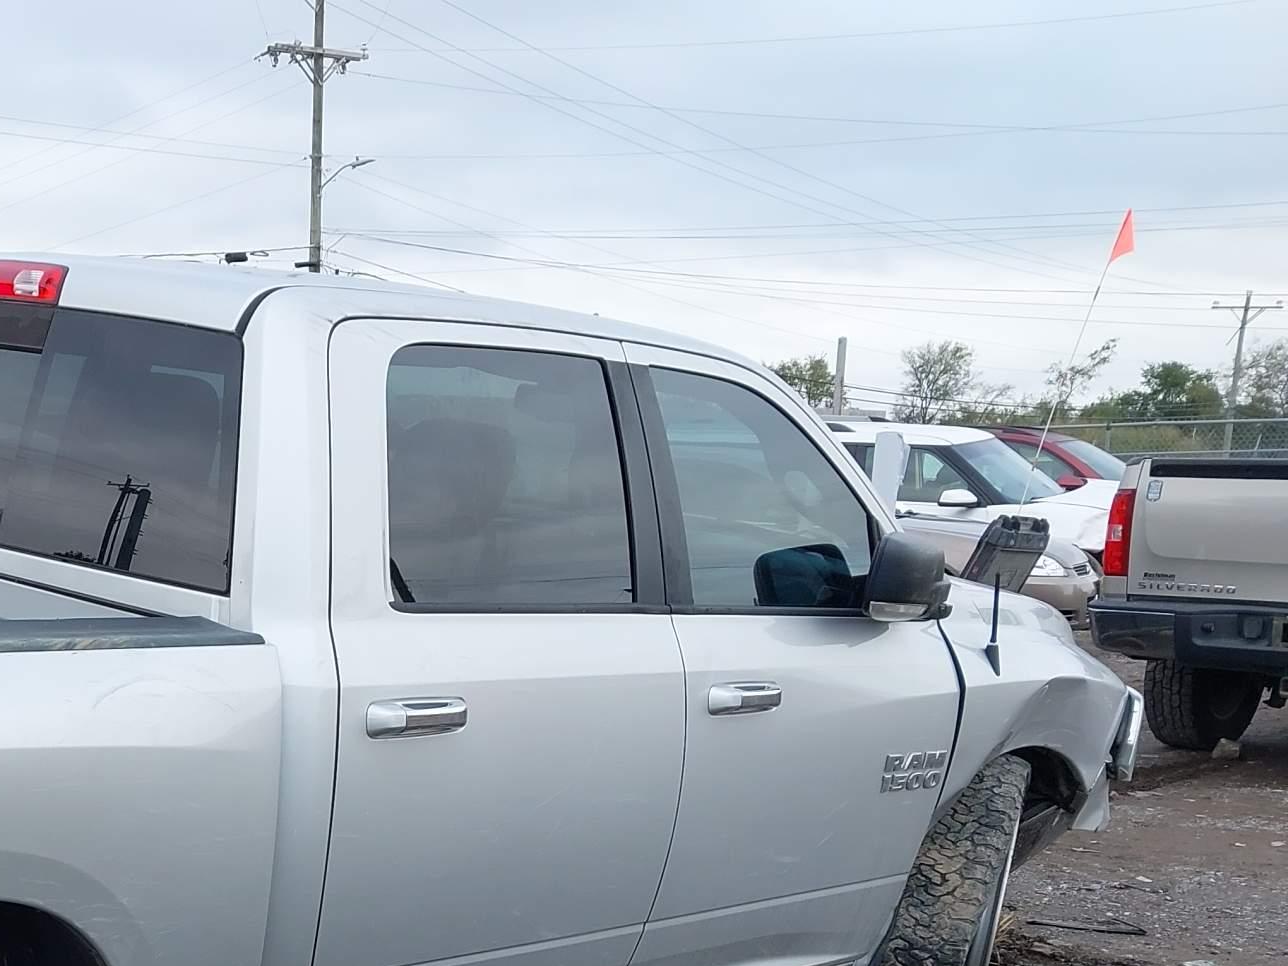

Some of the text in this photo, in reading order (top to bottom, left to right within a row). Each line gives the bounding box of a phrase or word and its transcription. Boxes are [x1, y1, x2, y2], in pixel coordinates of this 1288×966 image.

[1137, 582, 1237, 595] SILVERADO
[883, 749, 948, 772] RAM
[880, 770, 942, 793] 1500
